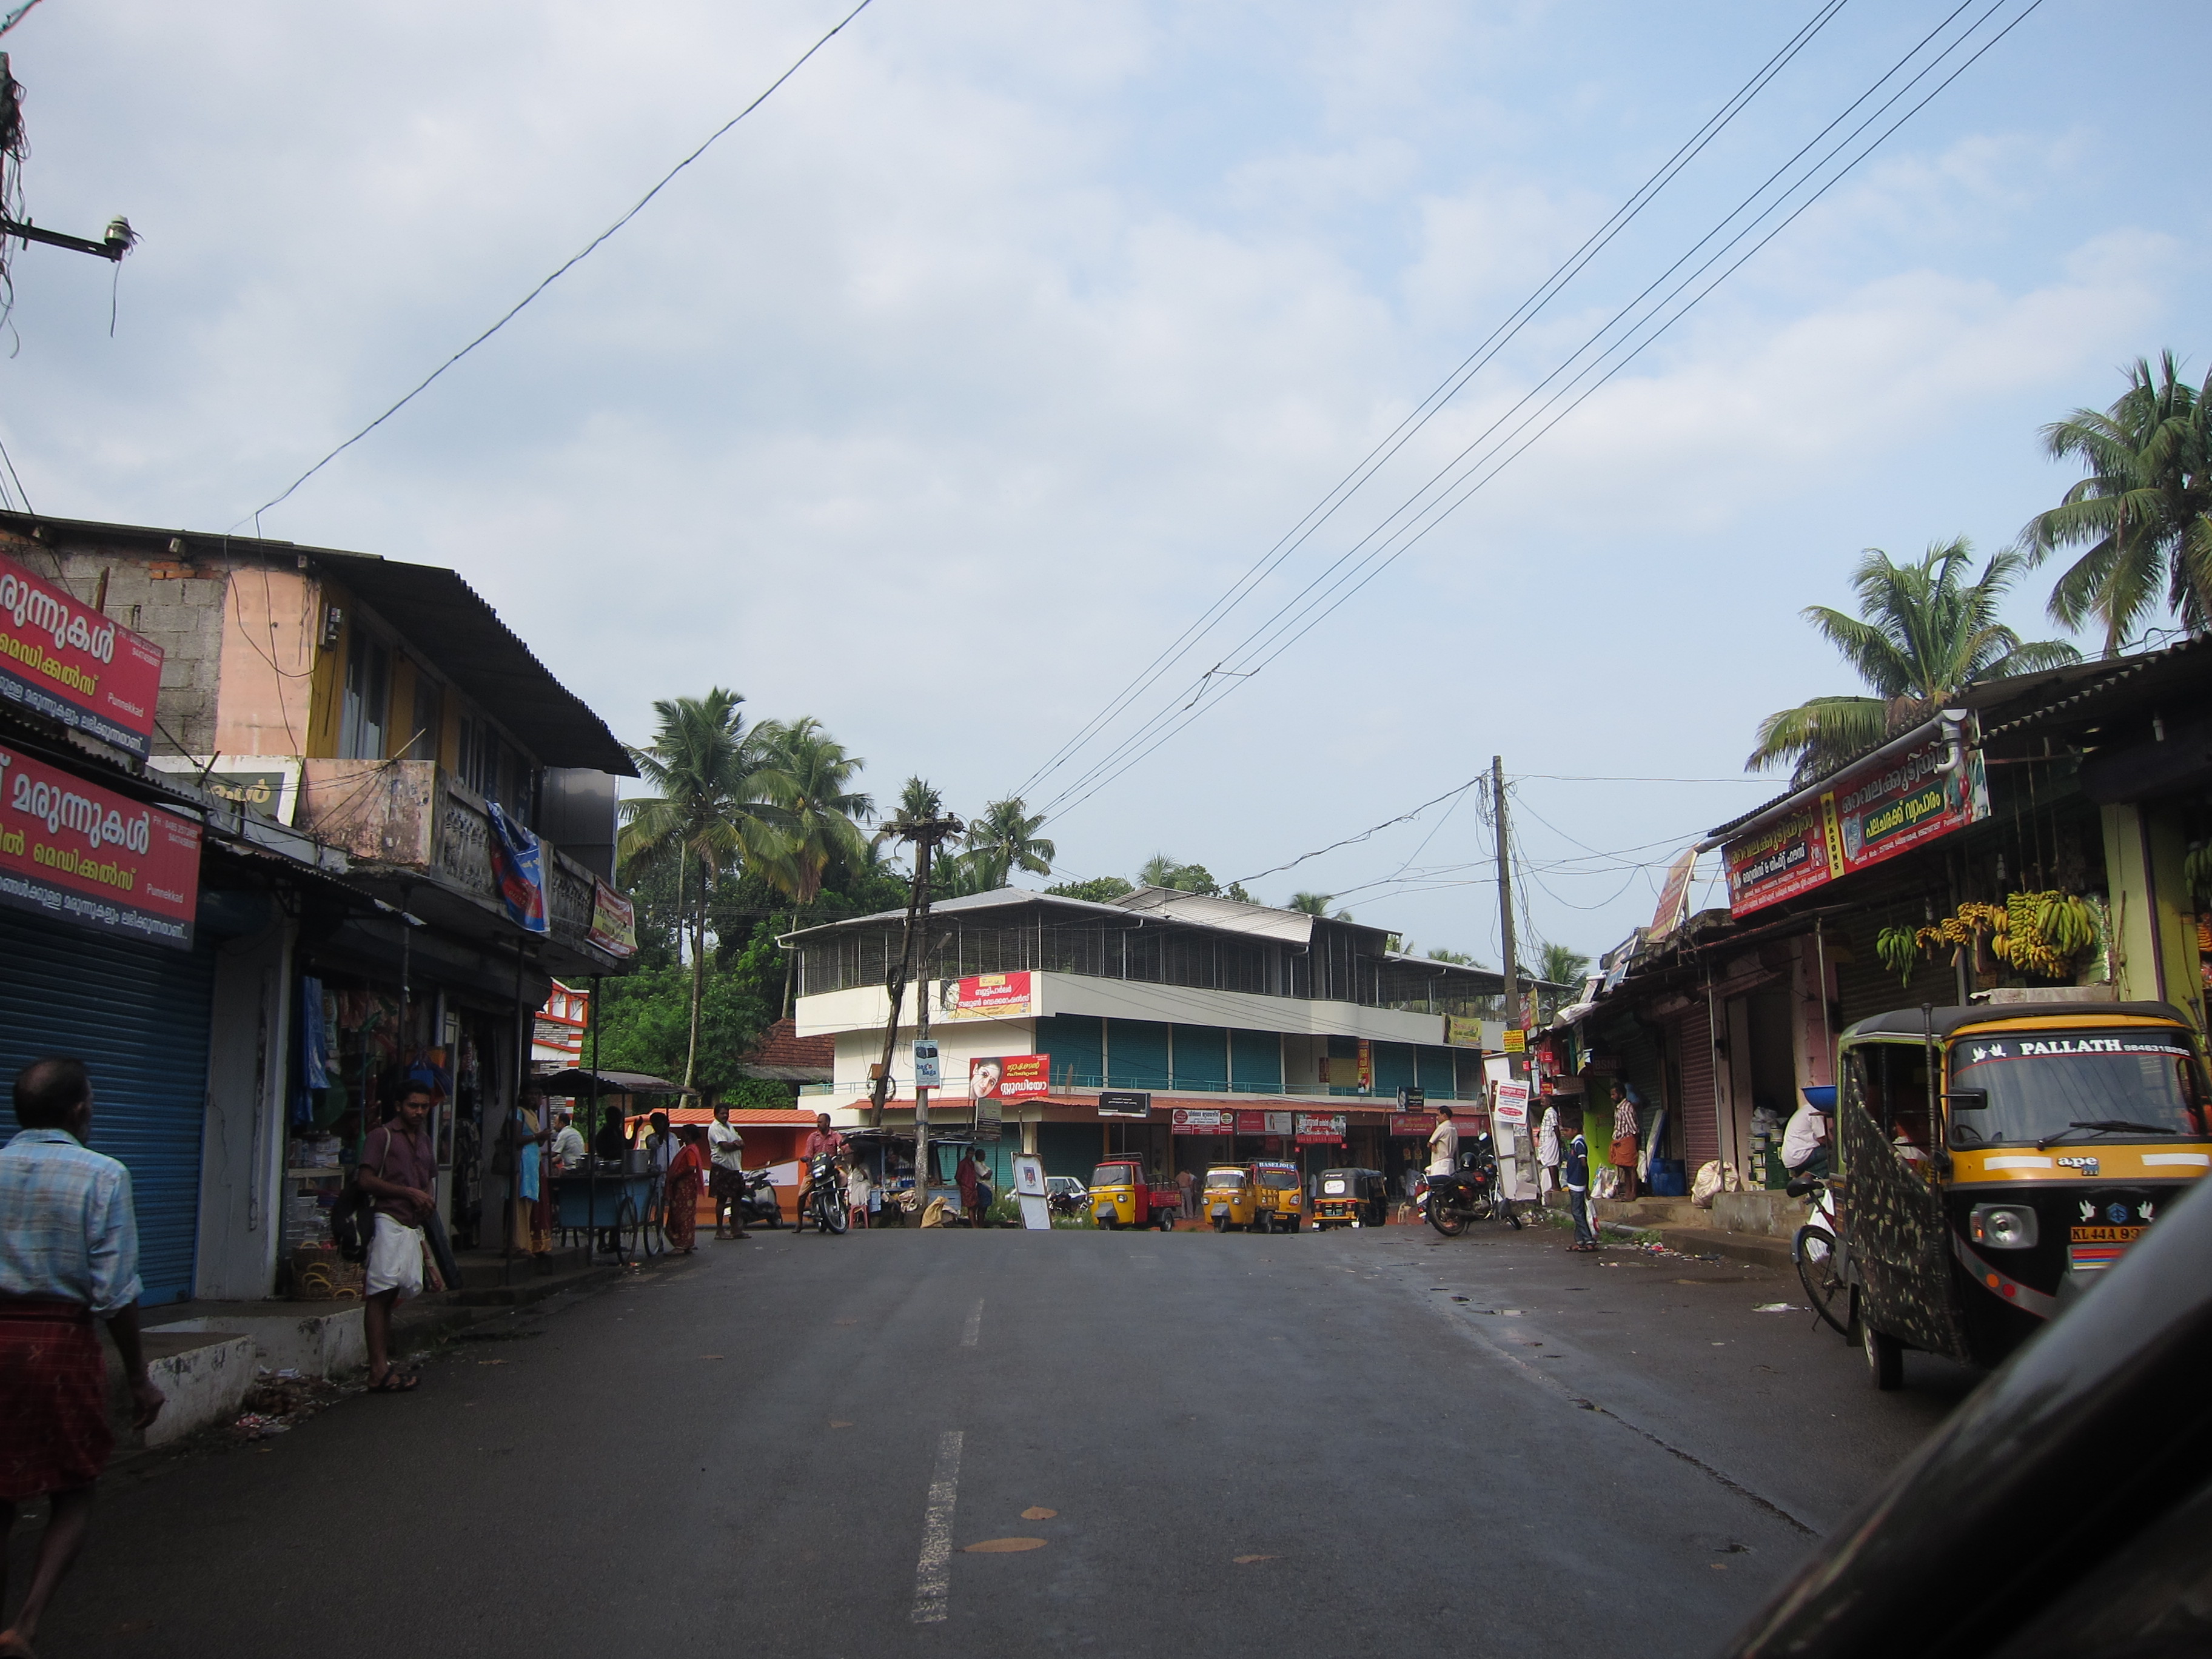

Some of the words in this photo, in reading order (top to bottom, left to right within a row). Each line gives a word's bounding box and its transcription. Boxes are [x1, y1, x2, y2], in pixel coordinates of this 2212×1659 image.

[108, 692, 144, 717] Punnekkad
[12, 774, 150, 855] മരുന്നുകൾ
[33, 842, 137, 891] മെഡിക്കൽസ്
[147, 883, 184, 903] Punnekkad
[2019, 1039, 2123, 1056] PALLATH
[2057, 1156, 2099, 1168] ape
